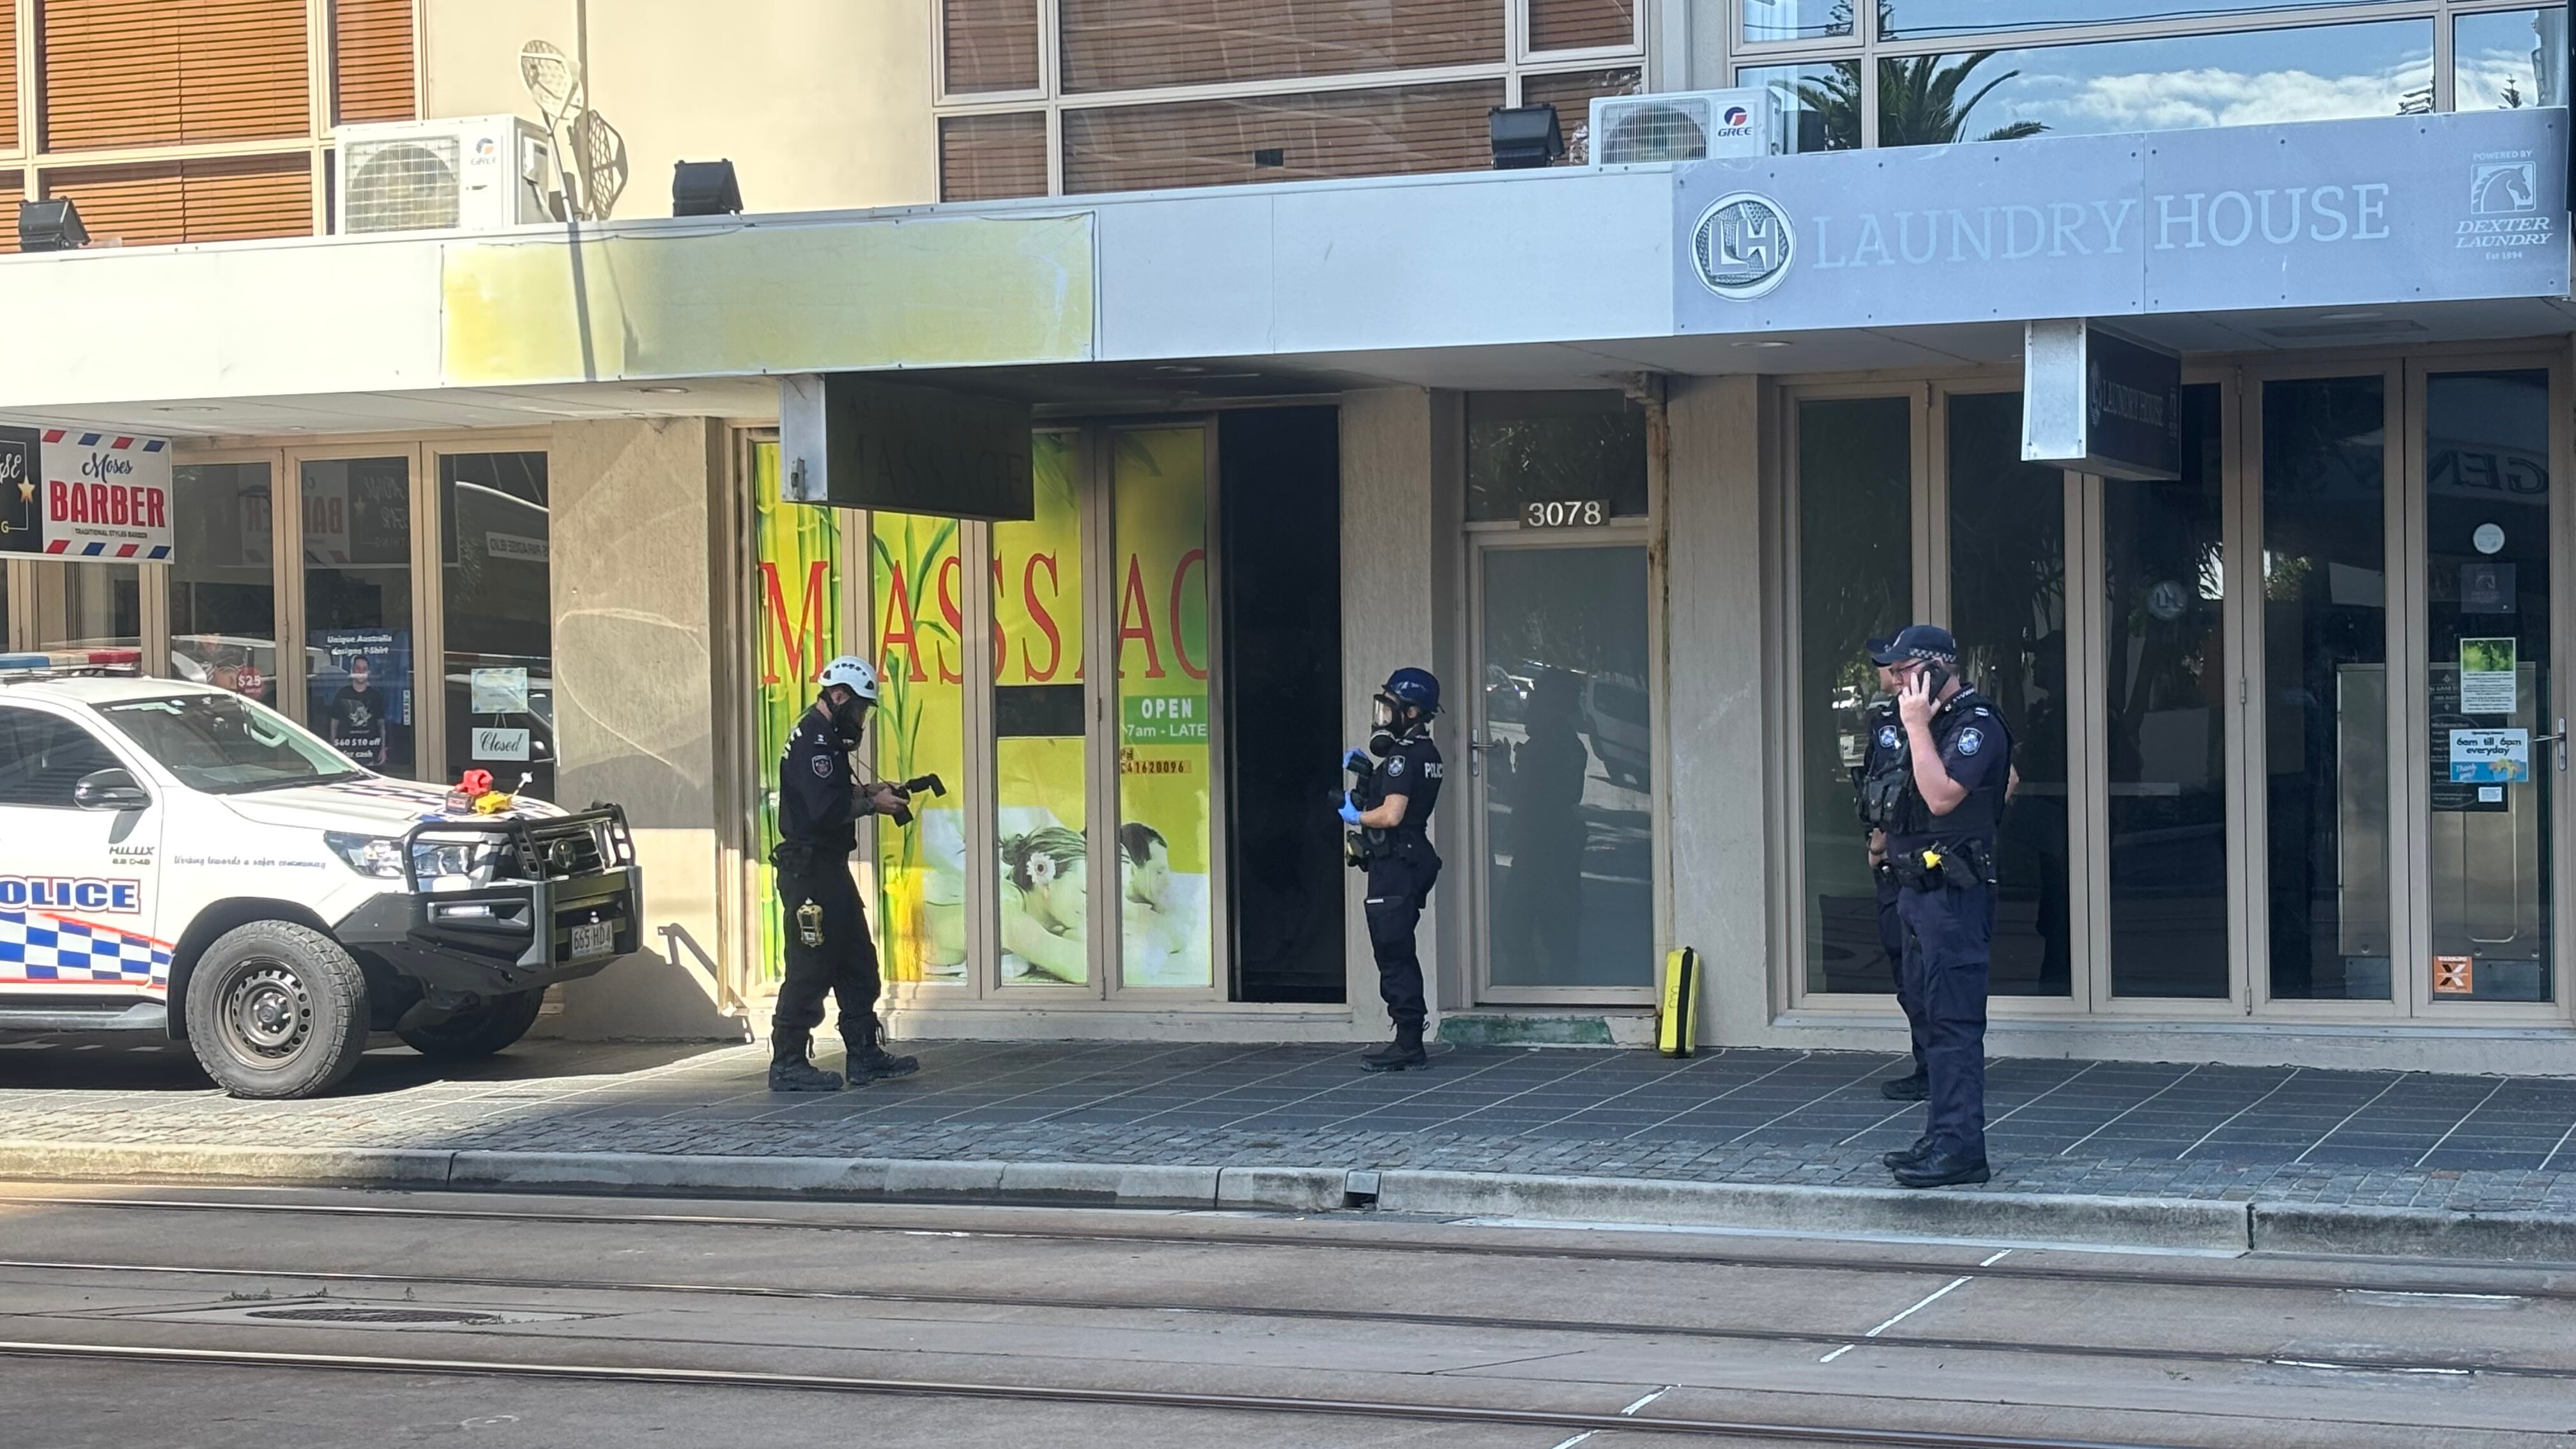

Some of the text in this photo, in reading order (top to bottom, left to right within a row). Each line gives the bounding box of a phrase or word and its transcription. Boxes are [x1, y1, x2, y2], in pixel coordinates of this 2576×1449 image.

[1717, 126, 1753, 137] GREE
[2472, 150, 2533, 160] POWERED BY
[1811, 183, 2389, 270] LAUNDRY HOUSE
[2455, 217, 2550, 234] DEXTER
[1709, 217, 1779, 275] LH
[2455, 233, 2554, 249] LAUNDRY
[2485, 251, 2523, 260] Est 1894
[82, 452, 134, 484] Moses
[49, 480, 166, 528] BARBER
[1528, 501, 1601, 527] 3078
[326, 634, 392, 645] Unique Australia
[331, 647, 362, 657] designs
[238, 674, 261, 688] $25
[1141, 698, 1192, 719] OPEN
[1127, 724, 1156, 737] 7am
[1169, 723, 1208, 737] LATE
[368, 737, 381, 746] off
[480, 730, 523, 753] Closed
[2456, 737, 2522, 747] 6am till 6pm
[355, 749, 374, 758] cash
[2465, 744, 2511, 756] everyday
[109, 846, 155, 856] HILUX
[207, 856, 241, 866] towards
[0, 878, 138, 911] OLICE
